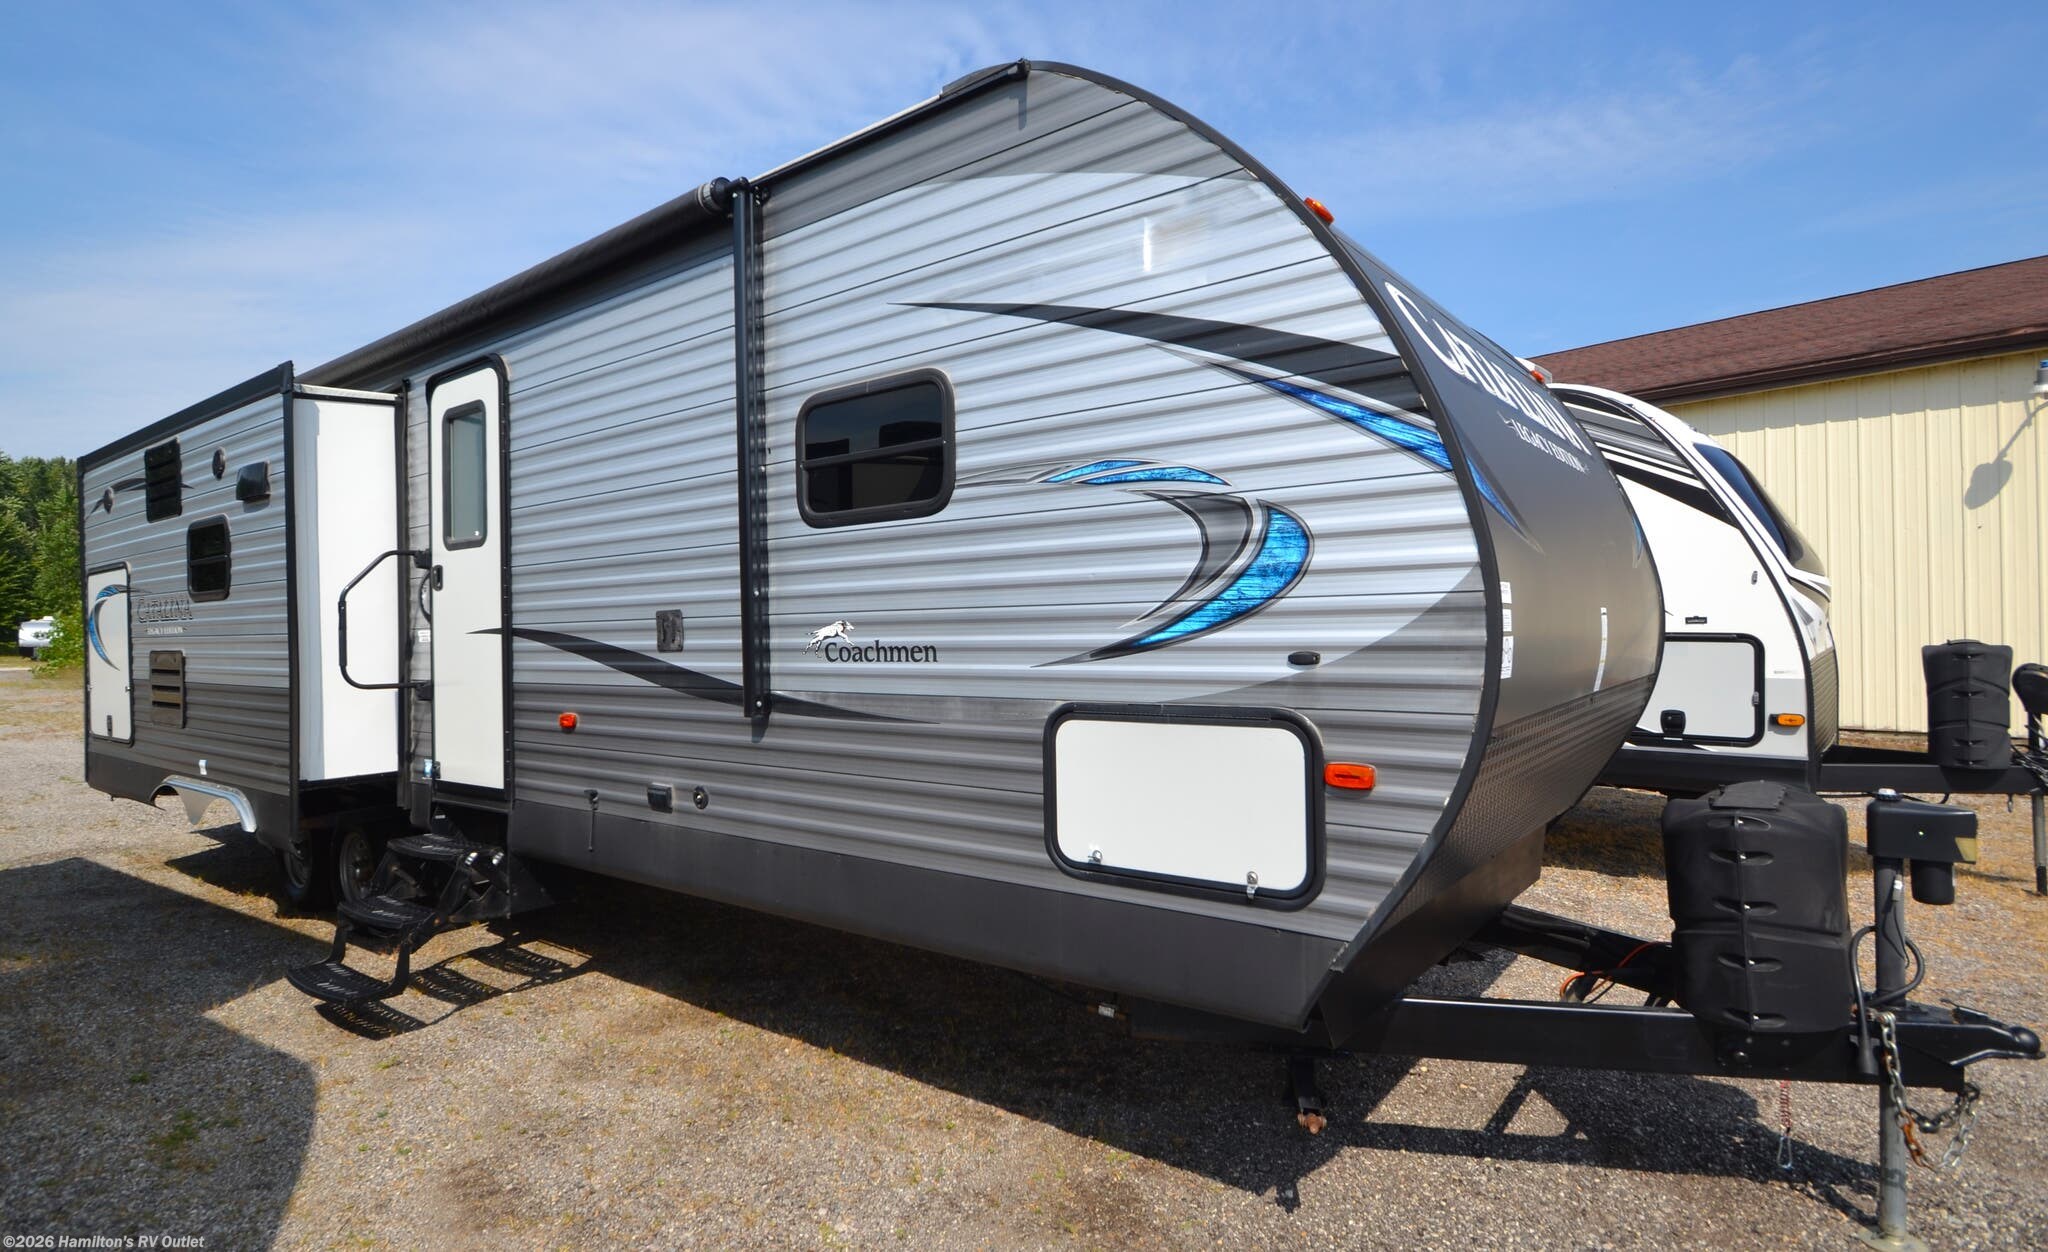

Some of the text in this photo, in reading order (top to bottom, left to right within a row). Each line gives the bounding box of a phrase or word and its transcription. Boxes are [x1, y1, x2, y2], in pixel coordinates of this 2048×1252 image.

[1384, 281, 1592, 456] CATALINA
[136, 597, 194, 623] CATALINA
[825, 640, 938, 663] Coachmen
